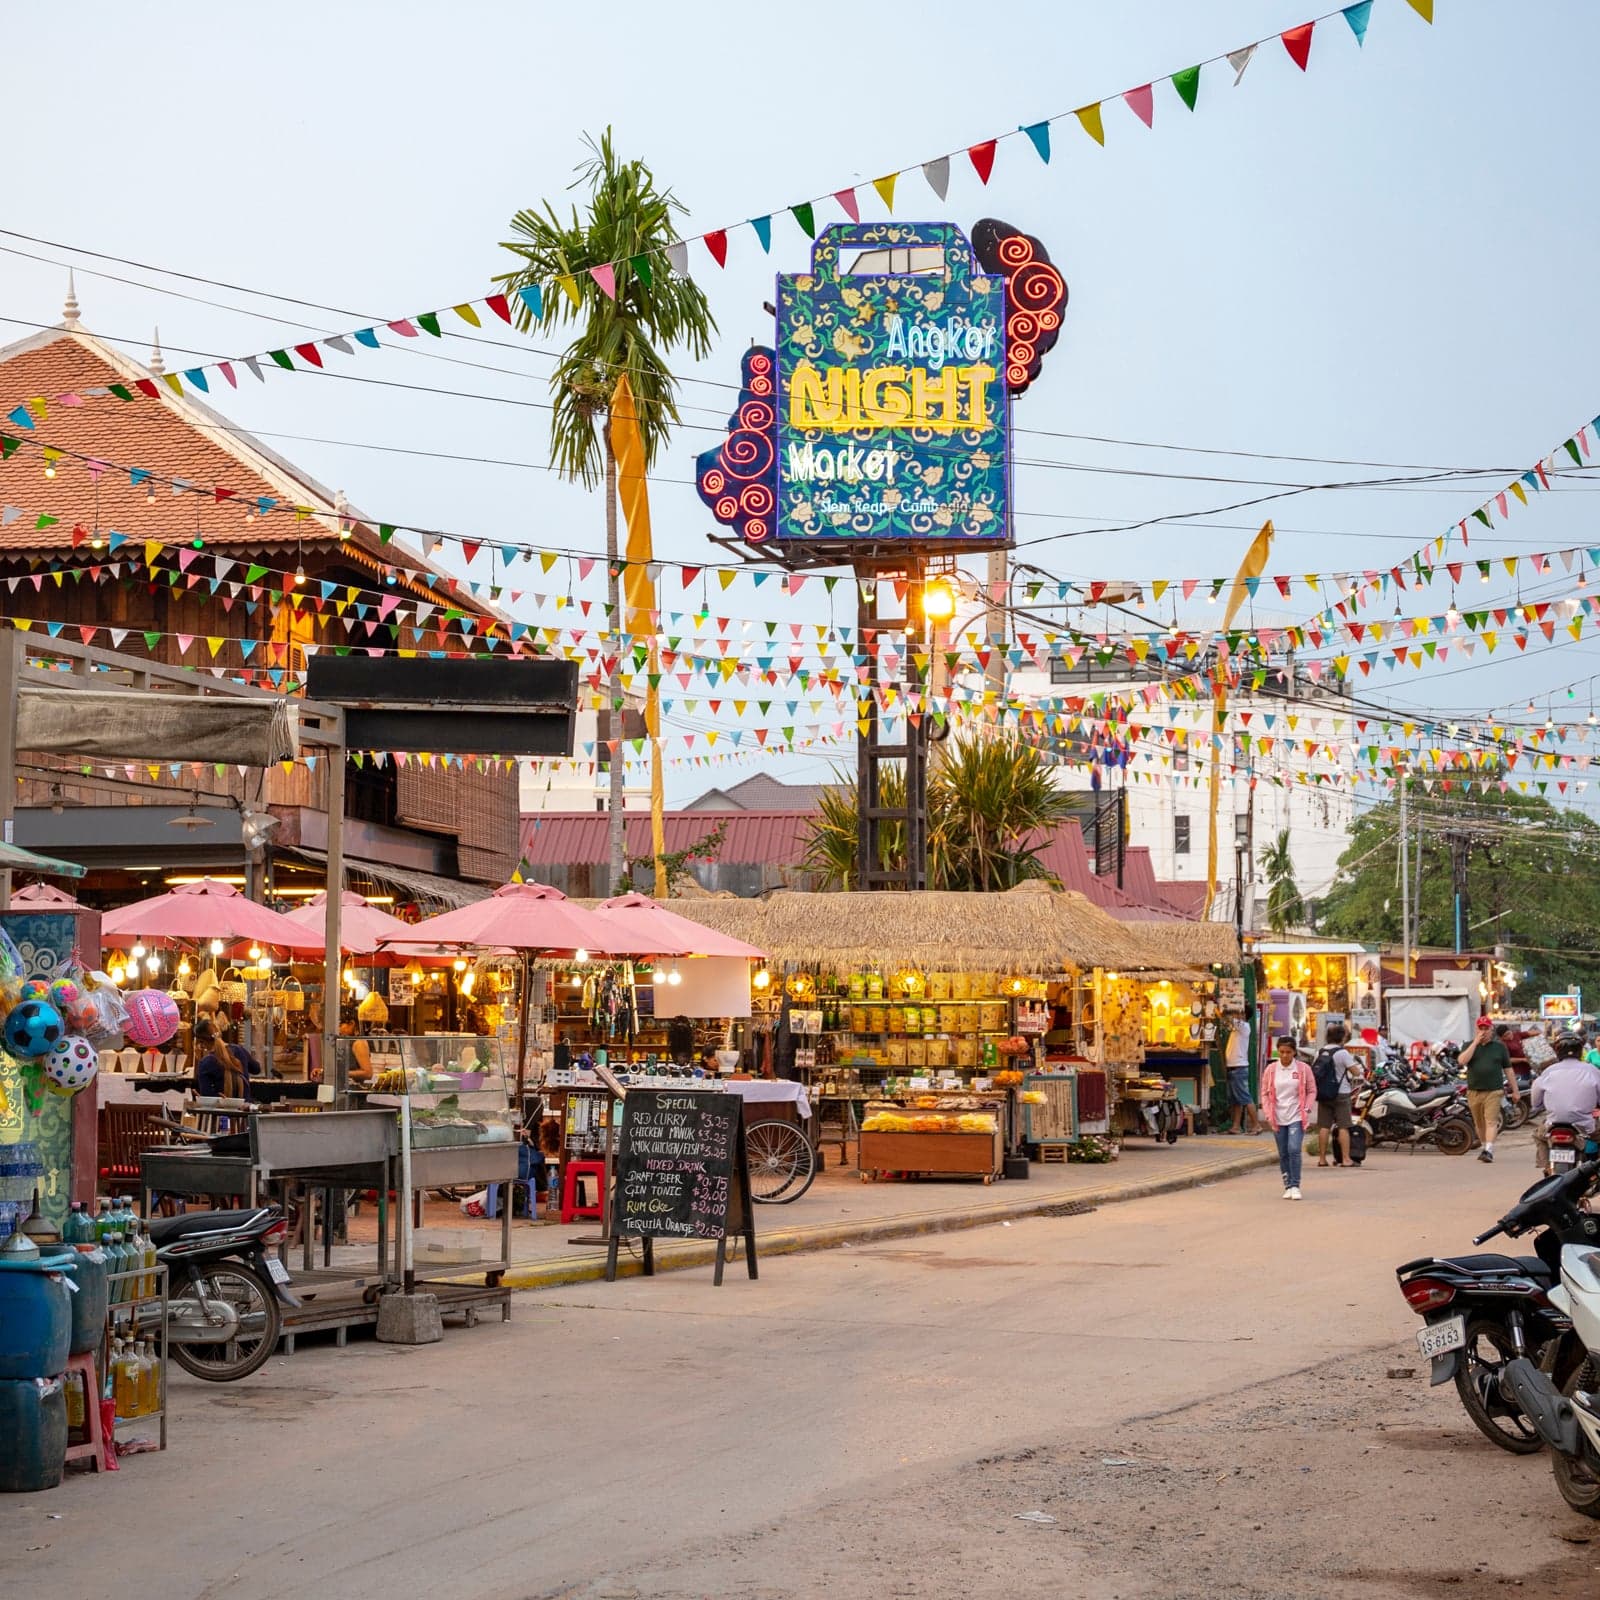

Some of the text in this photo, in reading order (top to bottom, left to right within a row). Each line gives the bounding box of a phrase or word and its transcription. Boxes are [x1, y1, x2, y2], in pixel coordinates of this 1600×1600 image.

[887, 316, 996, 370] Angkor
[790, 367, 996, 429] NIGHT
[788, 440, 897, 482] Market
[821, 500, 850, 512] Siem
[855, 501, 888, 516] Reap
[901, 497, 968, 513] Cambodia
[632, 1112, 729, 1129] RED CURRY $3.25
[630, 1126, 664, 1138] CHICKEN
[698, 1129, 728, 1145] $3.25
[630, 1140, 650, 1156] AMOK
[700, 1143, 728, 1160] $3.25
[647, 1159, 707, 1174] MIXED DRINK
[624, 1170, 655, 1182] DRAFT
[656, 1172, 683, 1184] BEER
[624, 1184, 727, 1202] GIN TONIC $2.00
[626, 1200, 646, 1213] RUM
[691, 1200, 726, 1216] $2.00
[694, 1219, 725, 1238] $2.50
